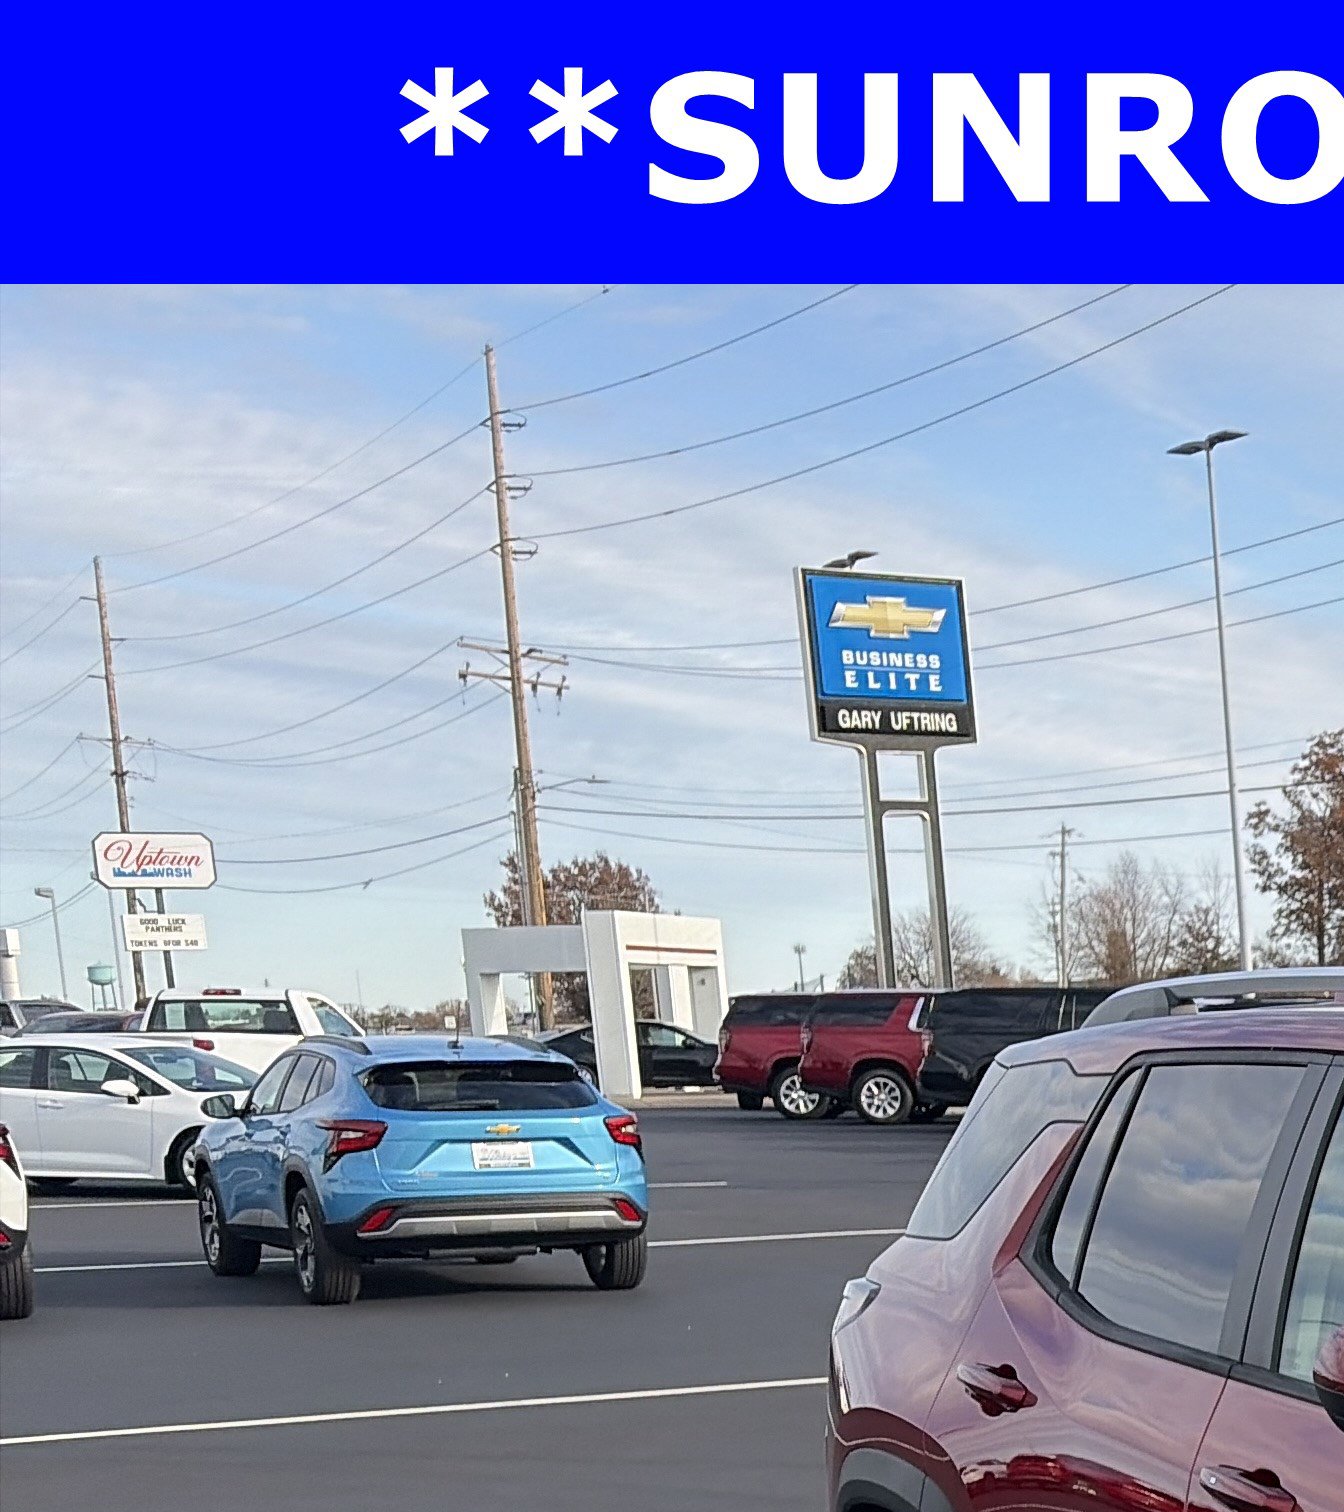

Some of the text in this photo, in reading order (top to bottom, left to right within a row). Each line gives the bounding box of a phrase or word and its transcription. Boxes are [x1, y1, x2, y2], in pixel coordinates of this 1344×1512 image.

[842, 650, 941, 668] BUSINESS
[844, 671, 942, 692] ELITE
[838, 709, 958, 732] GARY UFTRING
[103, 839, 204, 873] Uptown
[154, 867, 193, 878] WASH
[145, 925, 183, 933] PANTHERS
